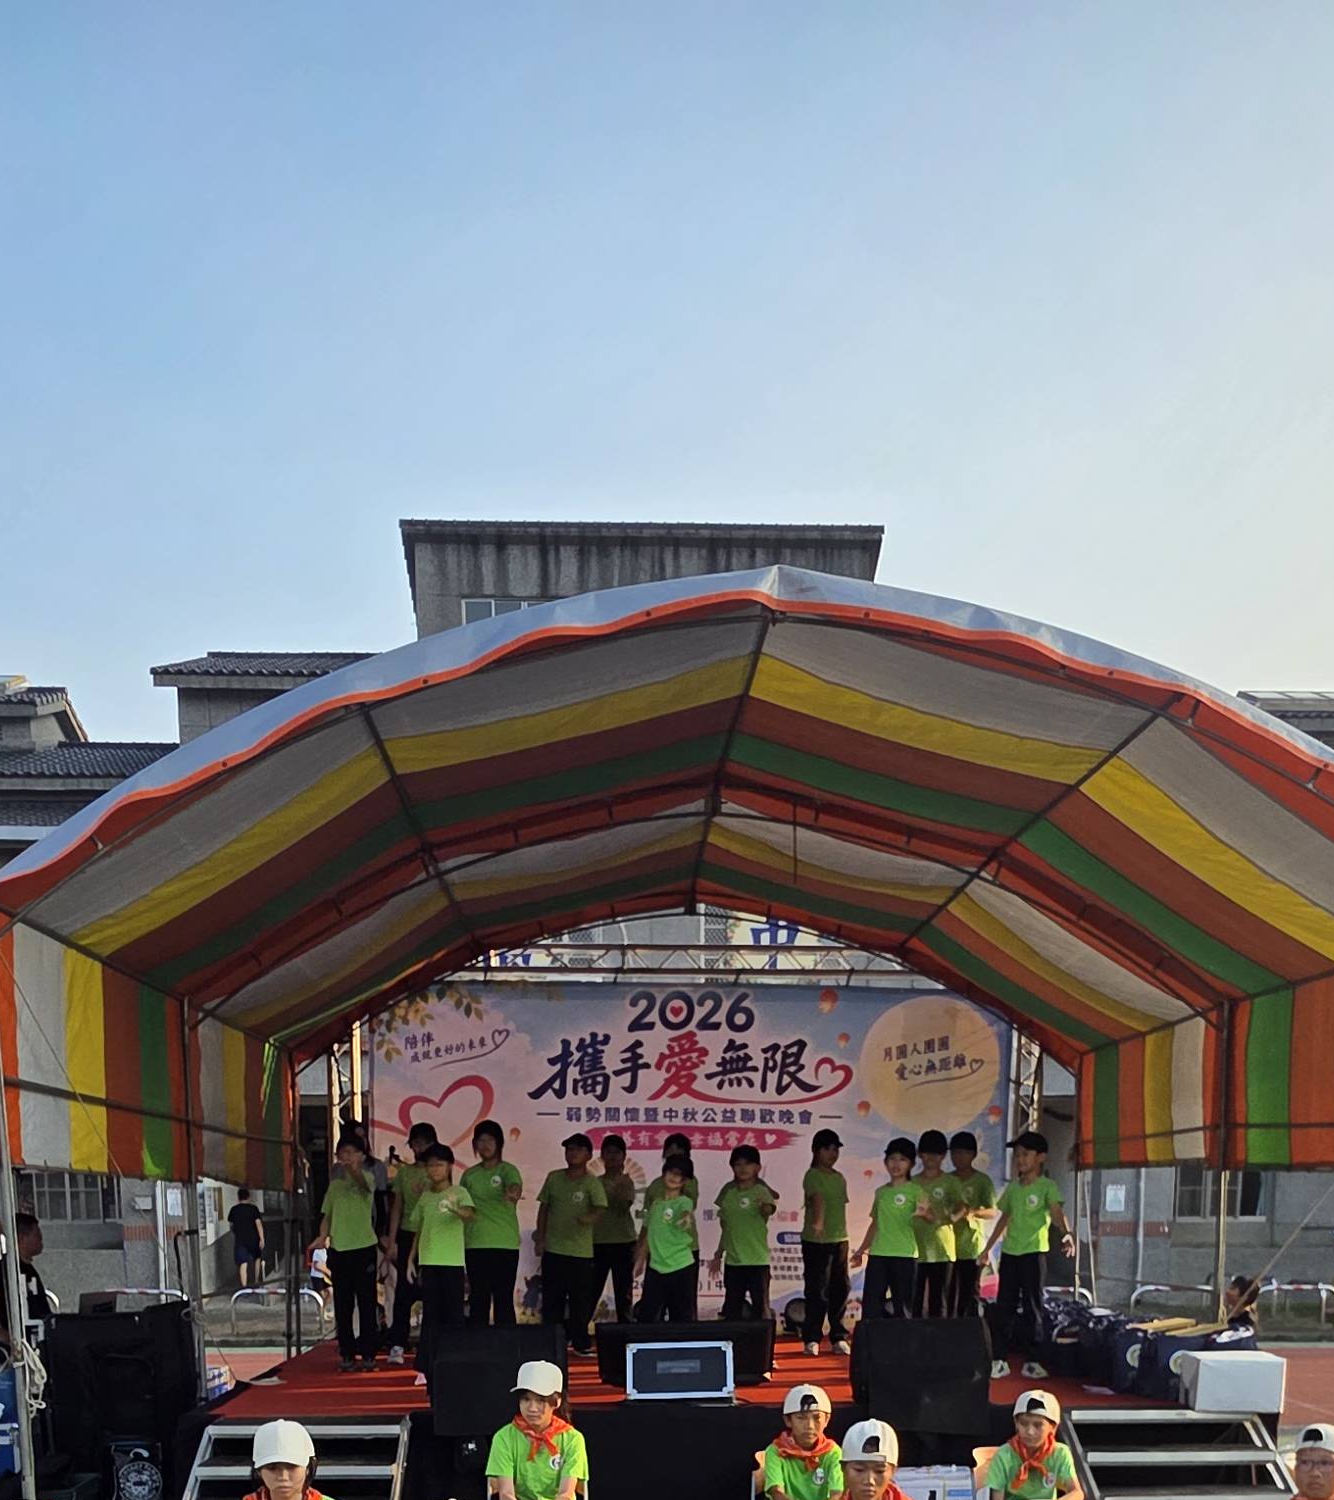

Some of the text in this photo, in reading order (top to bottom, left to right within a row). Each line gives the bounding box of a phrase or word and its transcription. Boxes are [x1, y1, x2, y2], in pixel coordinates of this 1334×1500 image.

[627, 990, 755, 1032] 2026
[527, 1030, 820, 1102] 攜手愛無限
